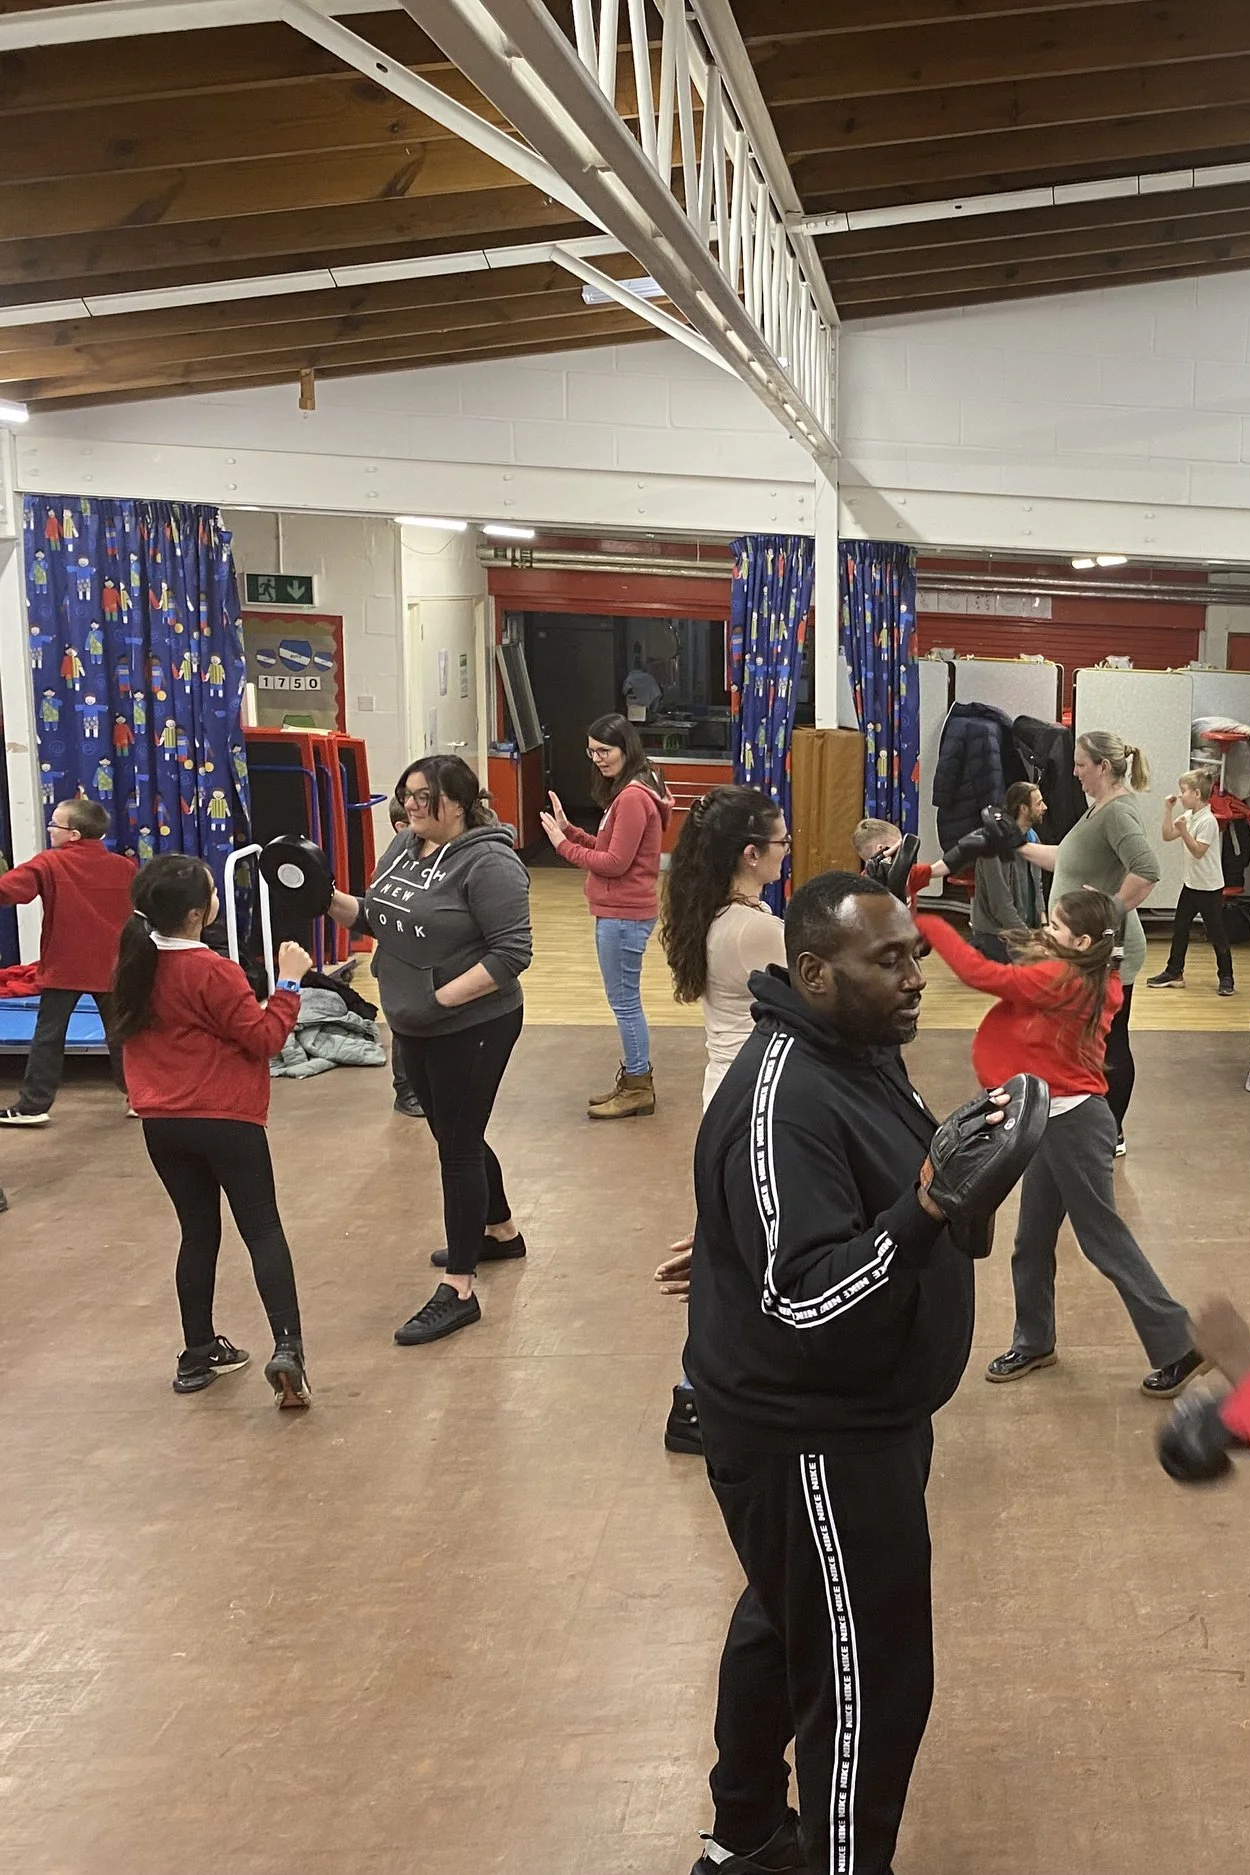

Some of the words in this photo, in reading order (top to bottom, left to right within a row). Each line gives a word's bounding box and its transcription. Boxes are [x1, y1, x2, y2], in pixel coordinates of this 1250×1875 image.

[380, 883, 415, 902] NEW
[365, 907, 426, 938] YORK
[756, 1116, 765, 1148] NIKE
[757, 1150, 767, 1182] NIKE
[761, 1185, 775, 1215] NIKE
[842, 1276, 870, 1299] NIKE
[809, 1462, 820, 1491] NIKE
[814, 1494, 826, 1522] NIKE
[820, 1525, 833, 1552] NIKE
[827, 1555, 839, 1582] NIKE
[833, 1585, 844, 1613] NIKE
[838, 1615, 848, 1642] NIKE
[841, 1646, 850, 1672] NIKE
[843, 1675, 852, 1701] NIKE
[845, 1704, 853, 1729] NIKE
[843, 1732, 852, 1758] NIKE
[840, 1761, 850, 1789] NIKE
[838, 1792, 847, 1818] NIKE
[838, 1820, 846, 1843] NIKE
[838, 1845, 846, 1873] NIKE
